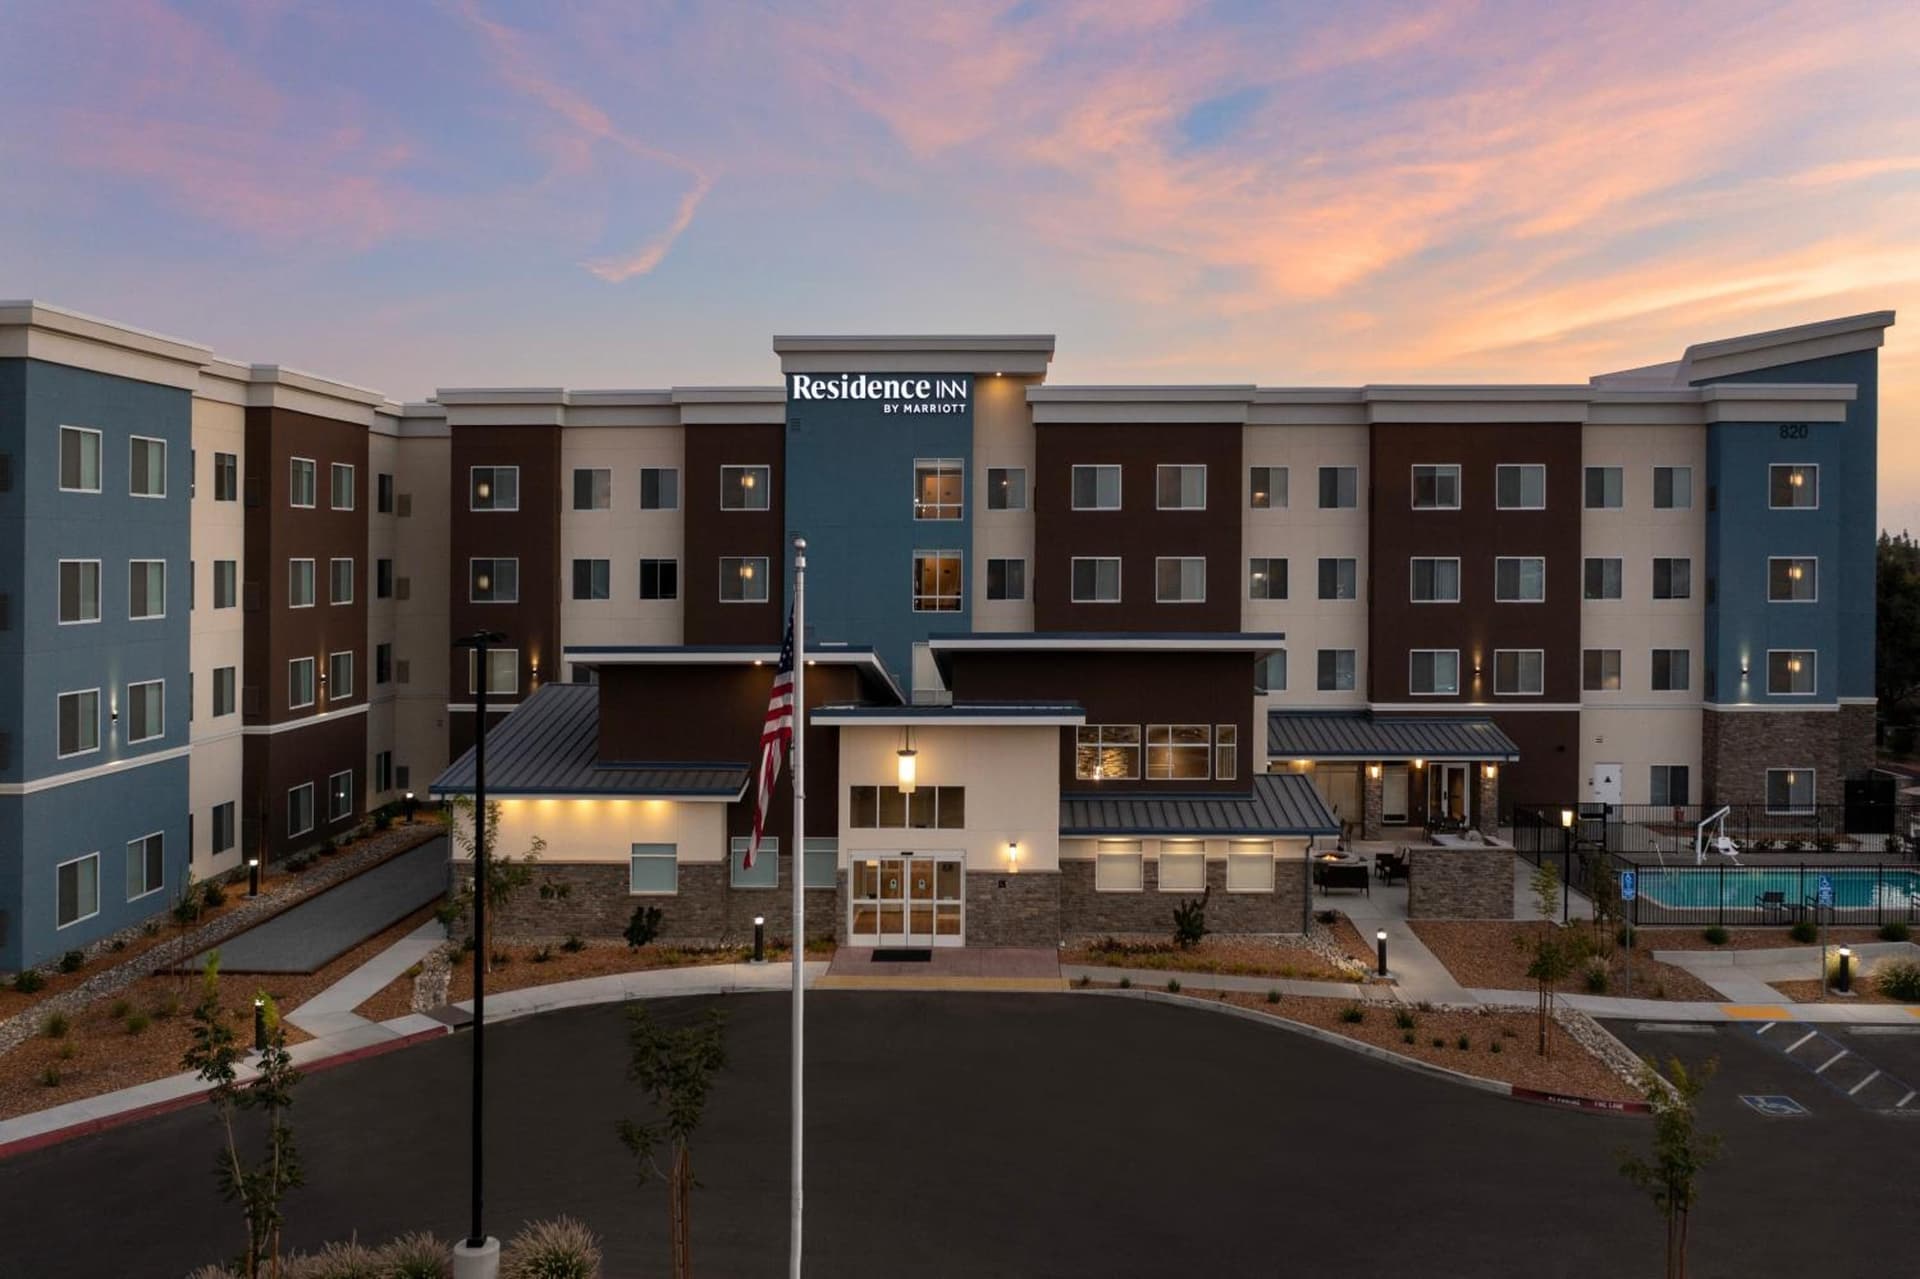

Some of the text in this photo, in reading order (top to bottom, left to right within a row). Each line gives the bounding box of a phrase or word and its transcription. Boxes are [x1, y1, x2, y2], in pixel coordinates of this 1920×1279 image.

[793, 374, 967, 399] Residence INN
[884, 404, 966, 413] BY MARRIOTT
[1780, 424, 1808, 438] 820
